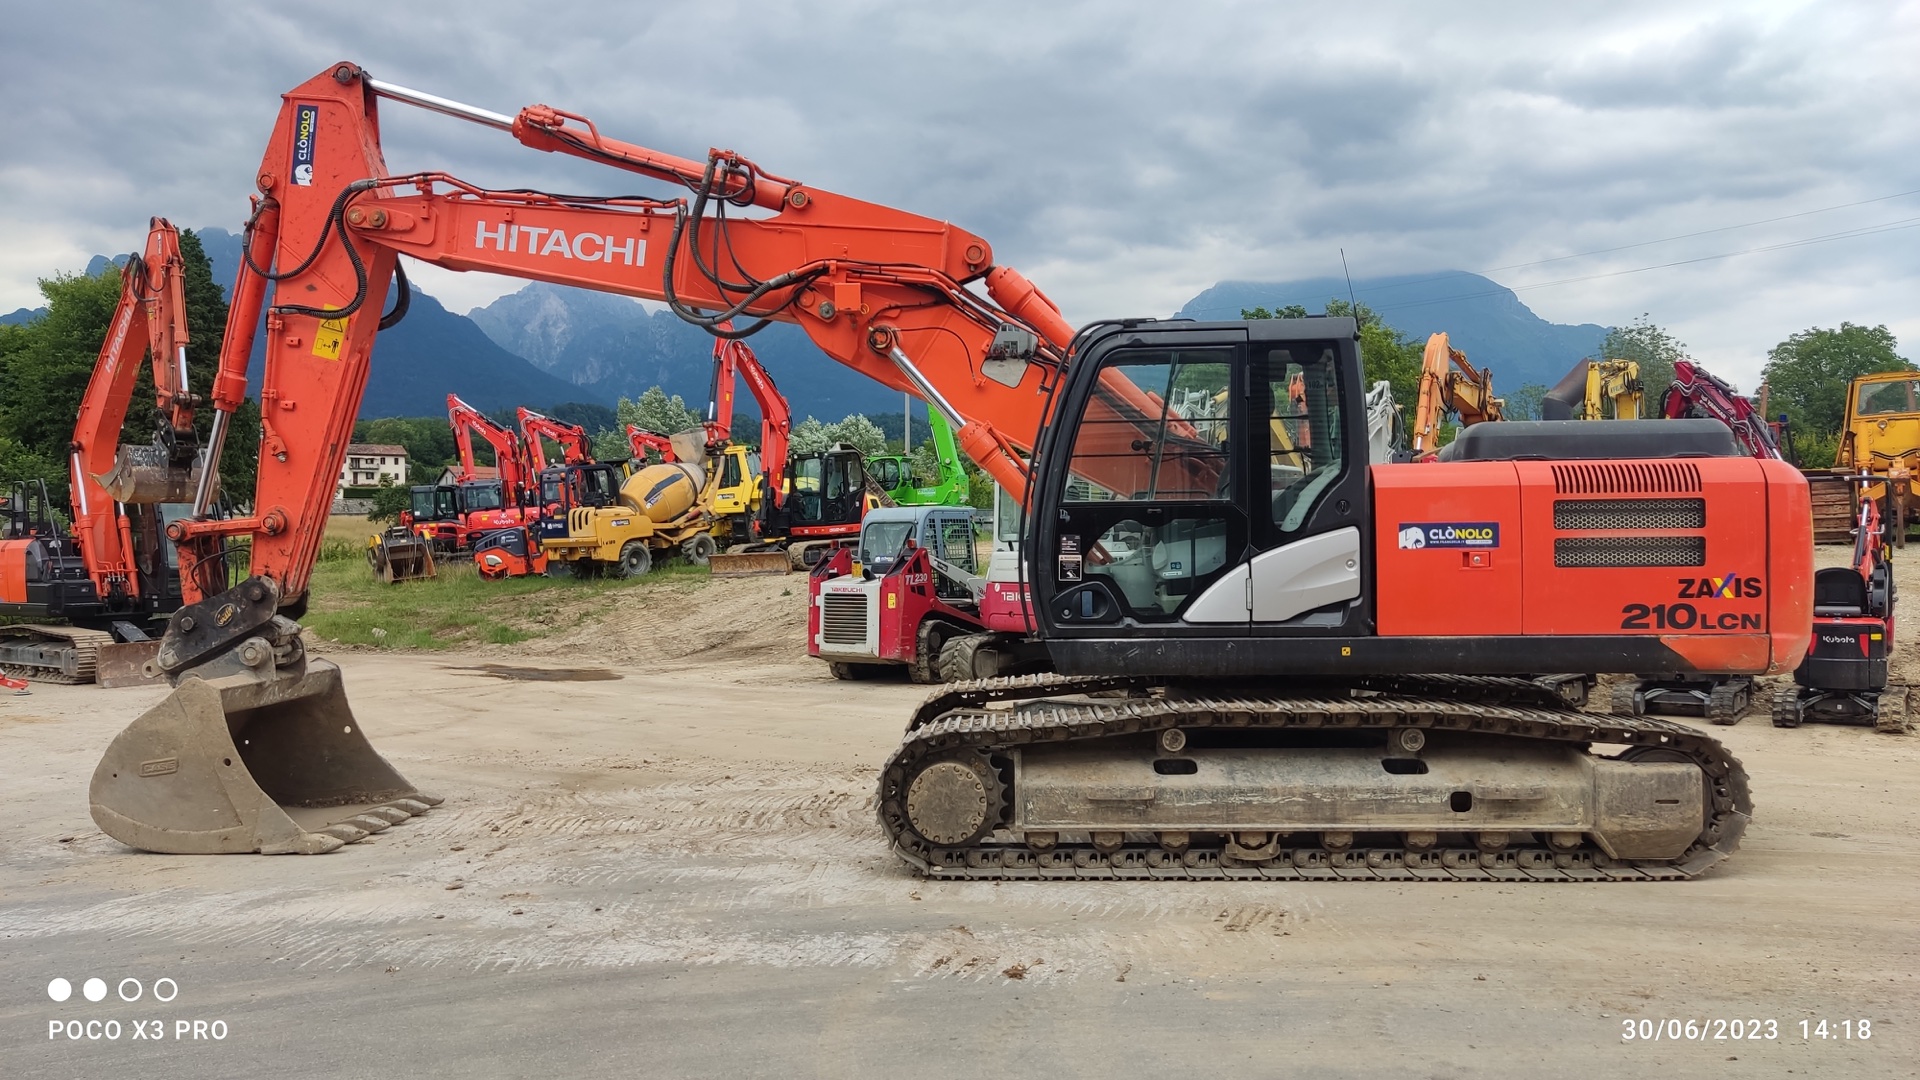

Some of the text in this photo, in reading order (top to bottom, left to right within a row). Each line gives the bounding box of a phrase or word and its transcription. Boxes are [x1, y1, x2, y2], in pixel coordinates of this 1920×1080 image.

[298, 110, 311, 161] CLÒNOLO
[475, 220, 648, 267] HITACHI
[105, 306, 133, 373] HITACHI
[1429, 526, 1493, 540] CLÒNOLO
[905, 573, 928, 585] TL230
[1678, 573, 1762, 599] ZAXIS
